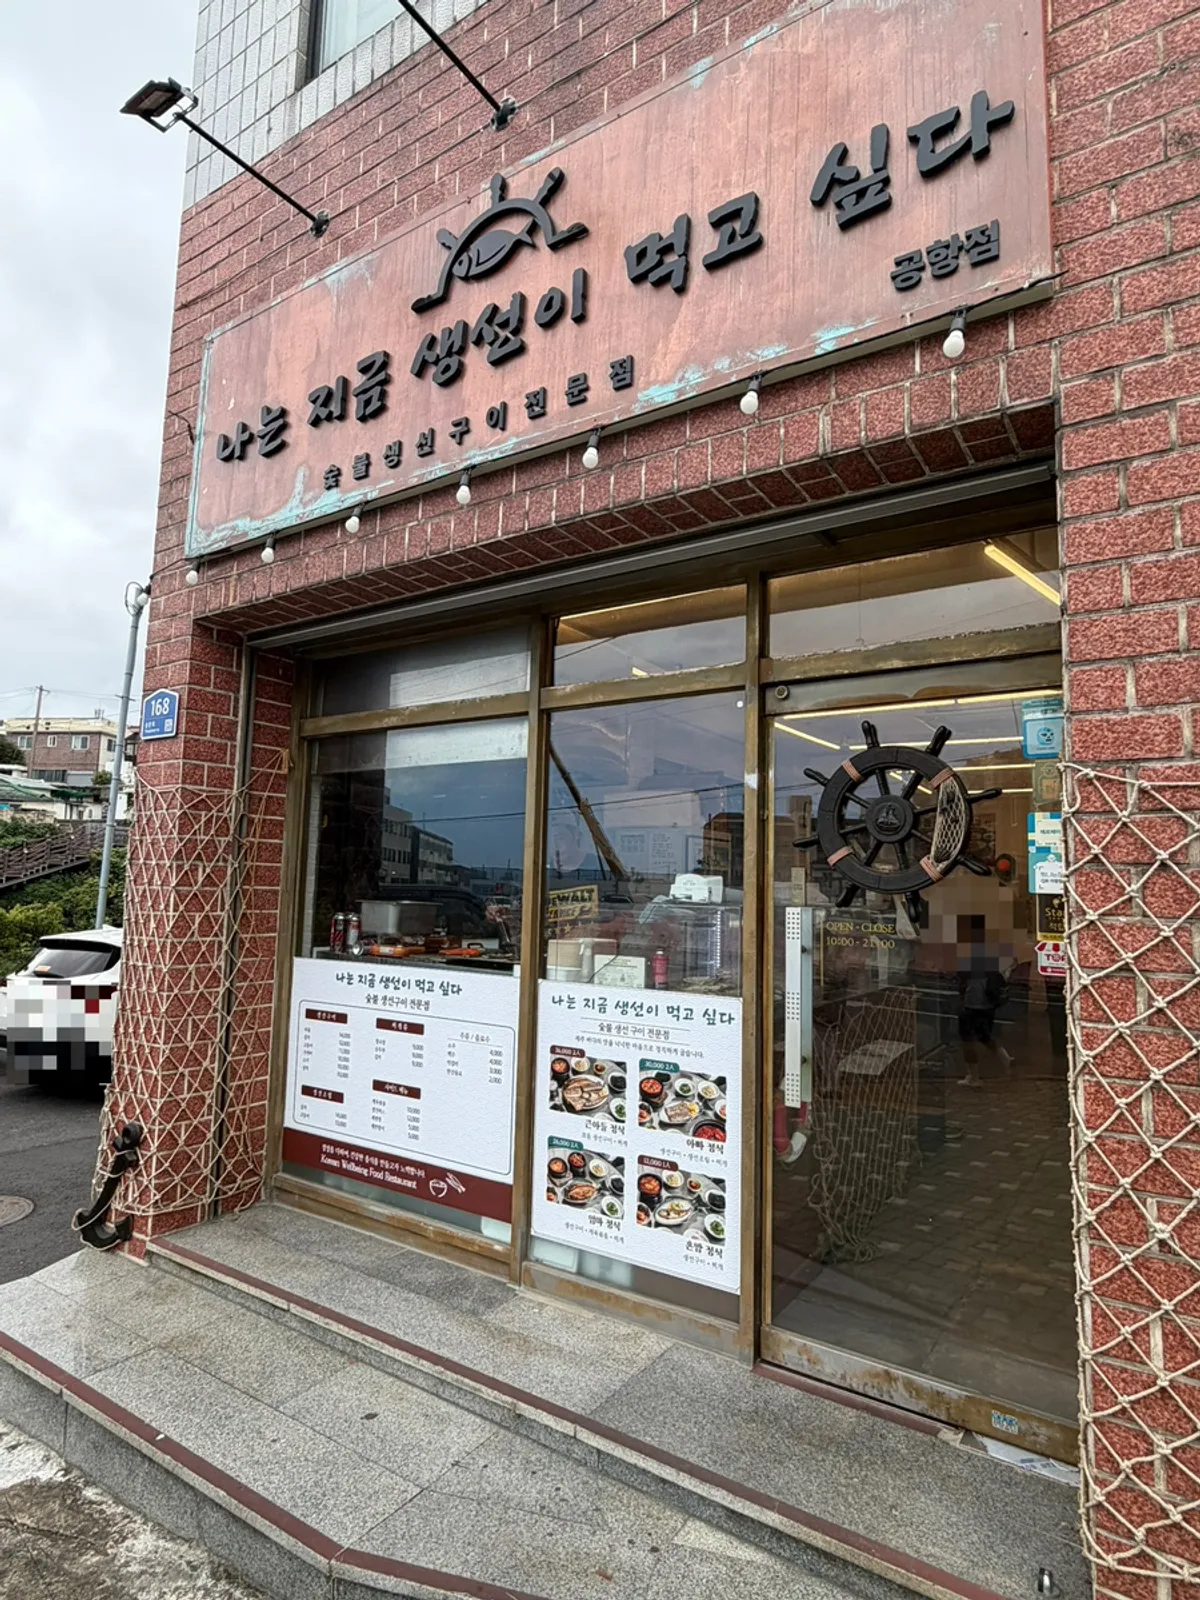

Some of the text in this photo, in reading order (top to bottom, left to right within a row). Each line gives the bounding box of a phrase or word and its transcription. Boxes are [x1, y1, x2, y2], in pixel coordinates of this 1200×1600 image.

[891, 218, 1000, 291] 공항점
[216, 90, 1015, 462] 나는 지금 생선이 먹고 싶다
[151, 697, 170, 716] 168
[826, 921, 854, 932] OPEN
[861, 923, 895, 933] CLOSE
[826, 936, 854, 946] 10:00
[862, 938, 895, 949] 21:00
[335, 971, 462, 996] 나는 지금 생선이 먹고 싶다
[365, 993, 378, 1004] 숯불
[409, 998, 430, 1011] 전문점
[552, 994, 735, 1026] 나는 지금 생선이 먹고 싶다
[598, 1022, 612, 1033] 숯불
[647, 1028, 670, 1040] 전문점
[609, 1123, 626, 1136] 정식
[686, 1138, 725, 1155] 아빠 정식
[341, 1158, 369, 1177] Wellbeing
[369, 1166, 384, 1180] Food
[384, 1170, 417, 1189] Restaurant
[605, 1218, 621, 1231] 정식
[705, 1244, 723, 1259] 정식
